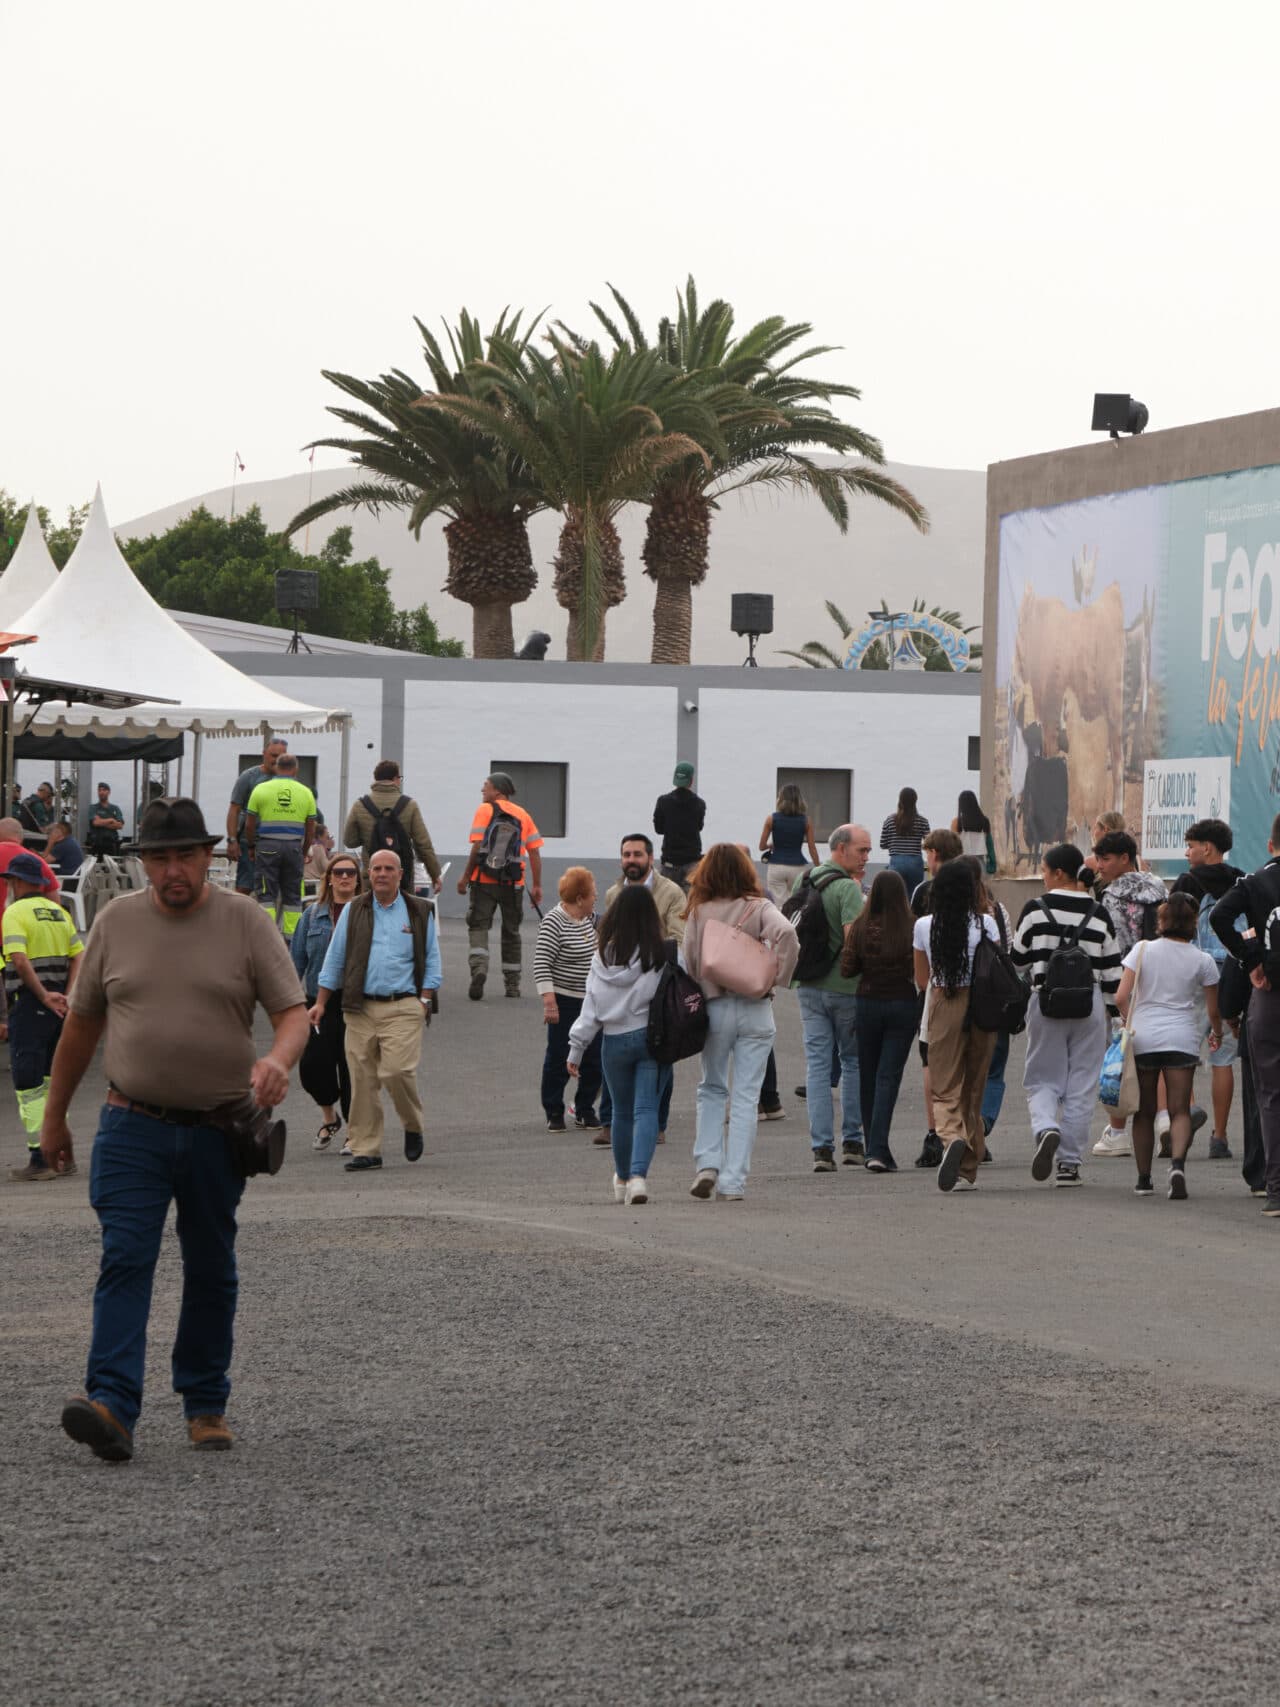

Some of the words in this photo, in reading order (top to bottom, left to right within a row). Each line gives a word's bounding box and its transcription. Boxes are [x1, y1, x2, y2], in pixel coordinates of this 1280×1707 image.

[1208, 614, 1232, 725] la
[1158, 771, 1186, 808] CABILDO
[1187, 771, 1197, 808] DE
